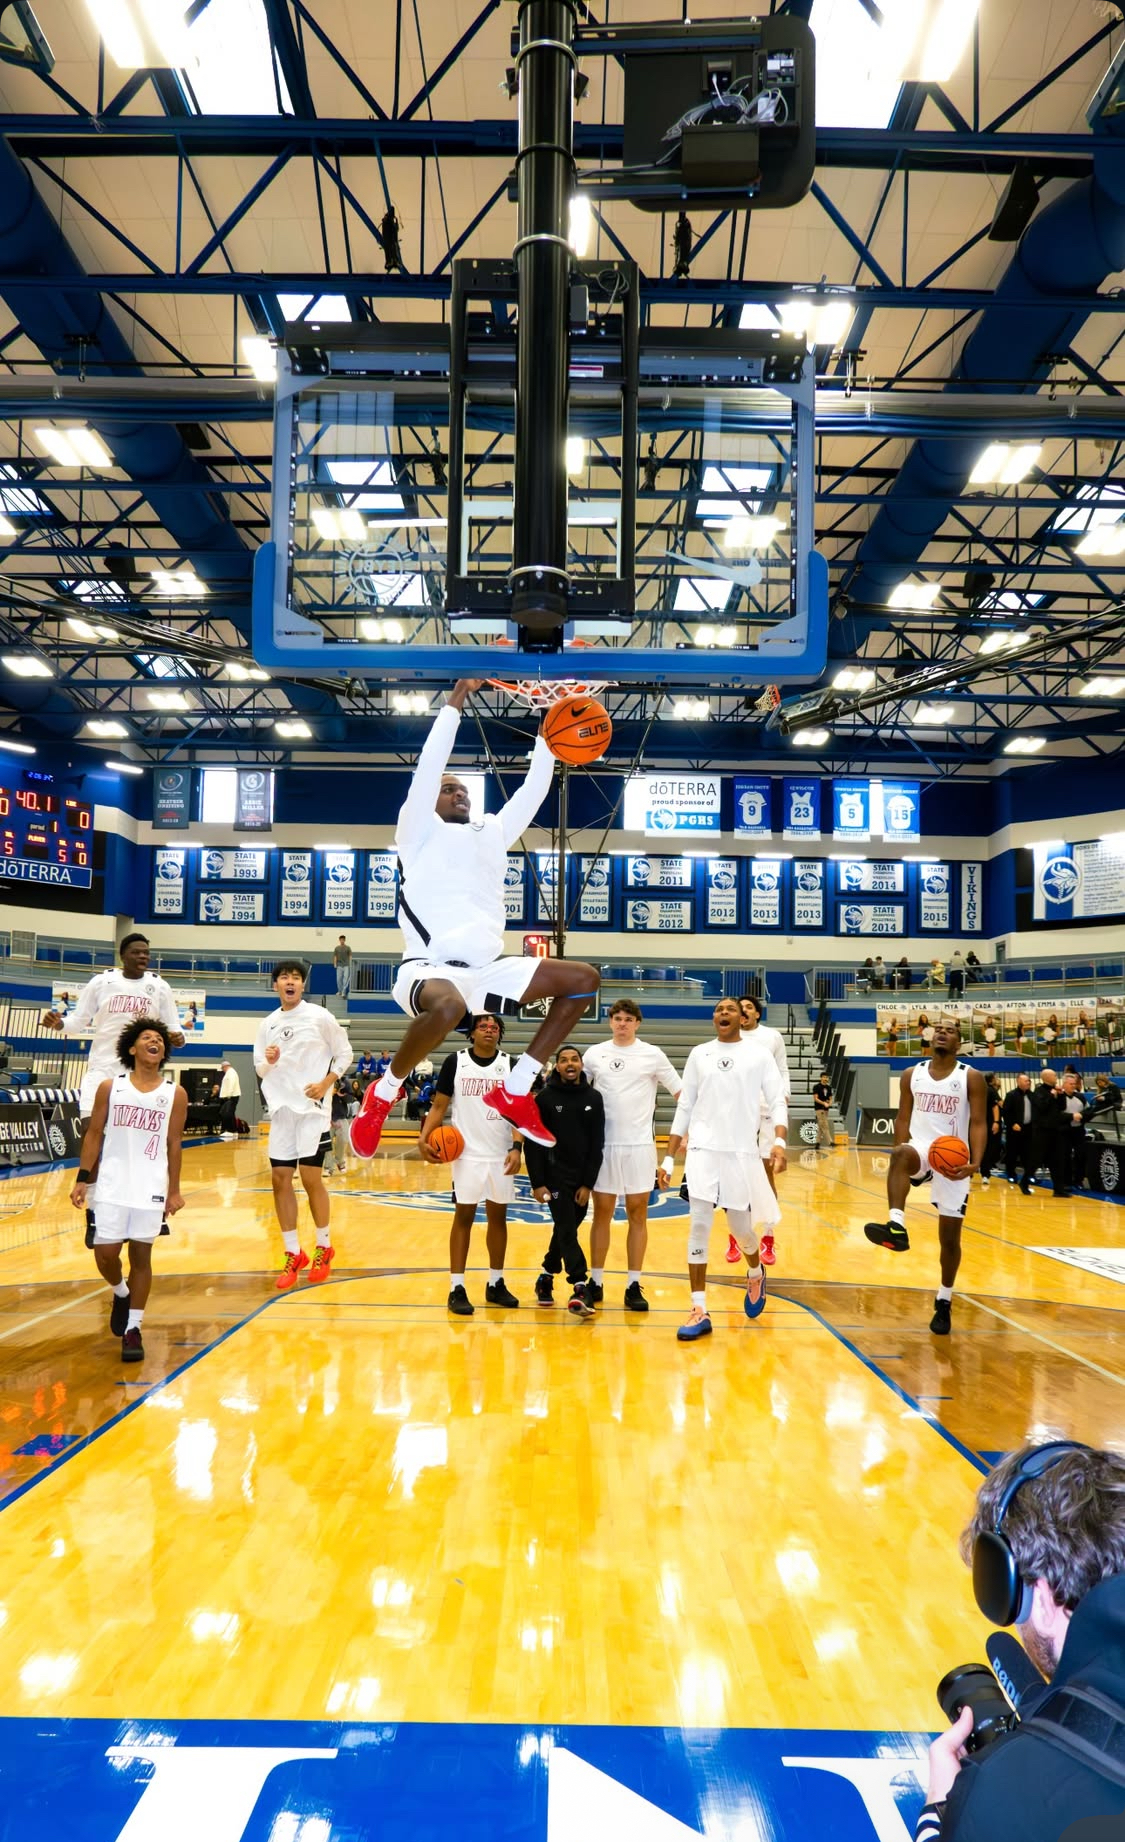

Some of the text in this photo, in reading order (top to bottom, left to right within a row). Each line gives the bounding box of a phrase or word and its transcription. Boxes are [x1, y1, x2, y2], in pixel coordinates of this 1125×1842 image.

[578, 722, 608, 738] ELITE
[16, 790, 50, 812] 40.1
[748, 806, 756, 816] 9
[794, 807, 809, 818] 23
[848, 808, 855, 818] 5
[894, 809, 908, 820] 15
[80, 812, 90, 830] 0
[680, 816, 713, 826] PGHS
[54, 821, 58, 833] 1
[5, 842, 14, 855] 5
[59, 850, 66, 863] 5
[79, 852, 88, 866] 0
[234, 869, 257, 878] 1993
[659, 876, 683, 885] 2011
[872, 881, 896, 890] 2014
[157, 898, 182, 906] 1993
[967, 866, 977, 929] VIKINGS
[284, 901, 308, 909] 1994
[328, 901, 351, 910] 1995
[370, 902, 394, 910] 1996
[582, 906, 607, 914] 2009
[232, 912, 255, 920] 1994
[710, 908, 734, 917] 2012
[753, 909, 777, 918] 2013
[797, 910, 821, 919] 2013
[923, 912, 948, 921] 2015
[658, 919, 683, 928] 2012
[872, 923, 896, 932] 2014
[109, 995, 152, 1015] TITANS
[462, 1078, 496, 1096] TITAN
[915, 1092, 960, 1115] TITANS
[114, 1104, 166, 1132] TITANS
[10, 1121, 39, 1140] VALLEY
[144, 1134, 160, 1160] 4
